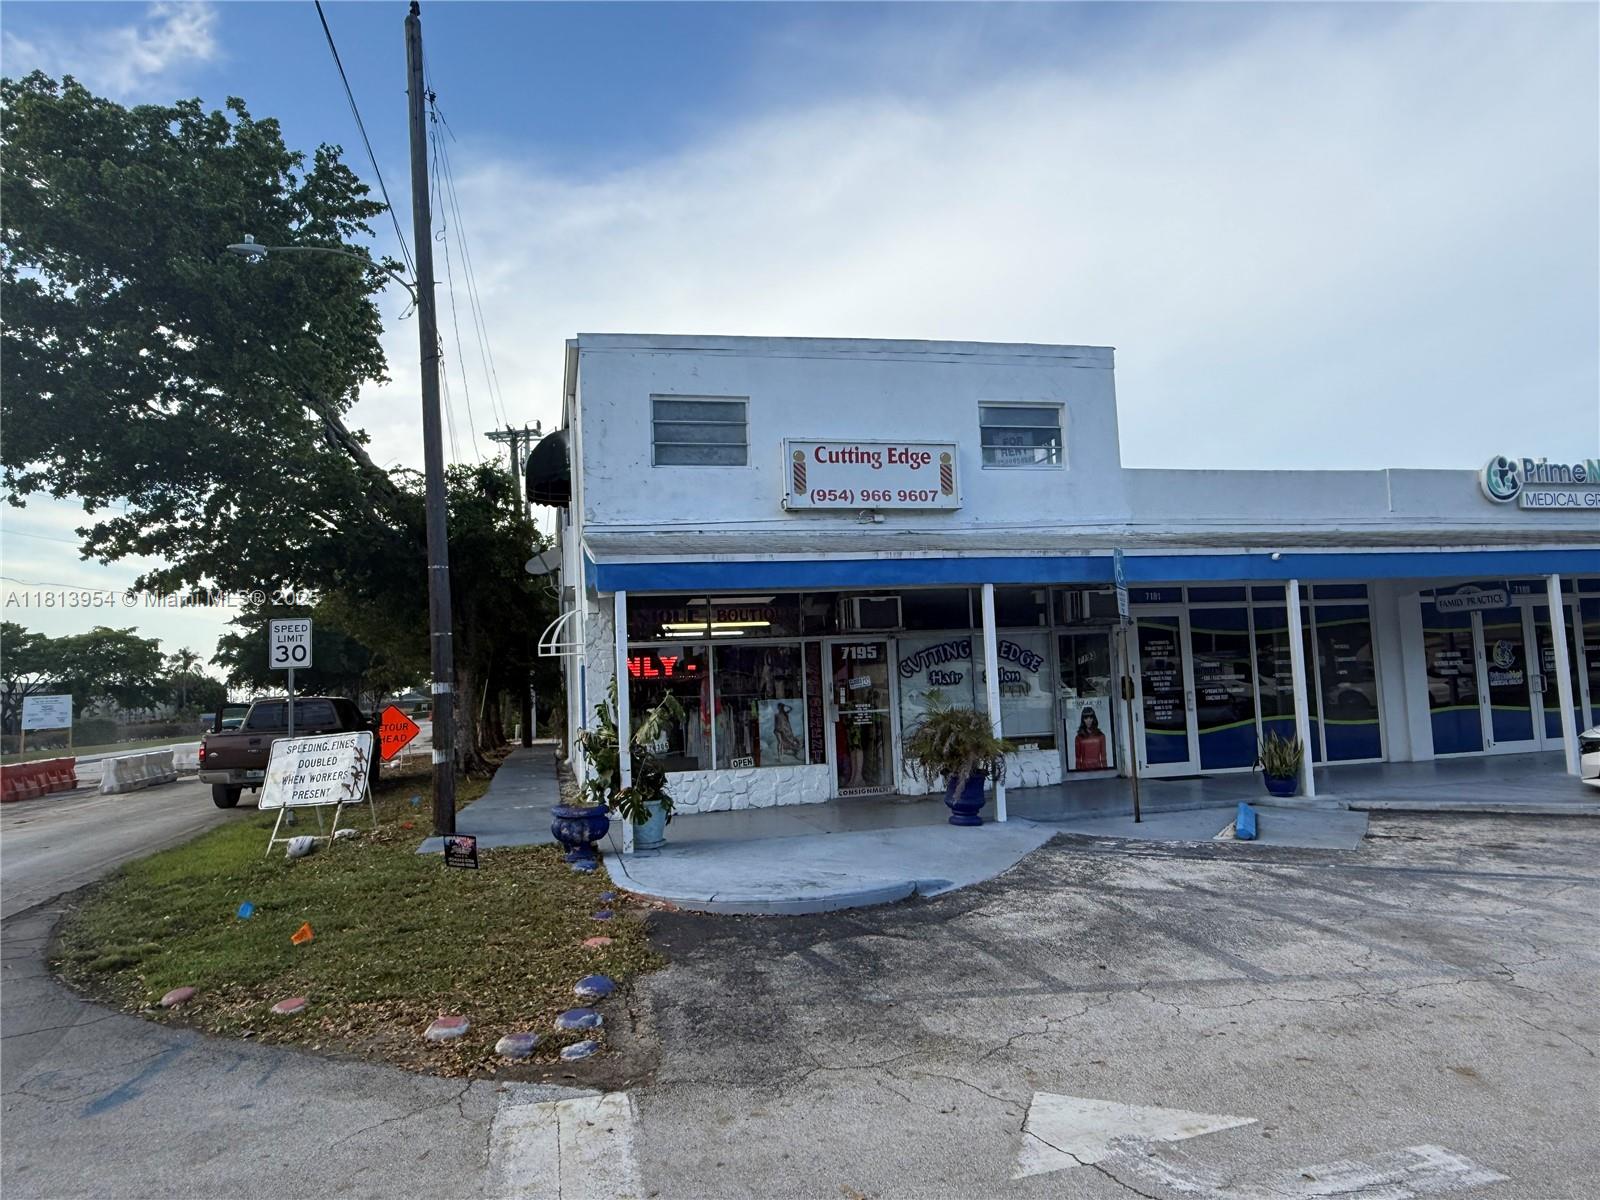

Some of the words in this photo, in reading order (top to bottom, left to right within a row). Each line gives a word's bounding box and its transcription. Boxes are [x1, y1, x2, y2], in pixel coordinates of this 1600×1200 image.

[814, 446, 882, 469] Cutting
[888, 447, 931, 470] Edge
[810, 489, 855, 504] (954)
[860, 489, 892, 503] 966
[897, 490, 938, 503] 9607
[1525, 492, 1581, 506] MEDICAL
[1466, 593, 1504, 607] PRACTICE
[274, 624, 308, 633] SPEED
[277, 634, 304, 644] LIMIT
[275, 645, 307, 663] 30
[841, 646, 877, 660] 7195
[898, 639, 972, 678] CUTTING
[999, 640, 1044, 673] EDGE
[627, 656, 678, 676] NLY
[929, 670, 963, 686] Hair
[983, 667, 1020, 684] lon
[331, 738, 356, 751] FINES
[298, 756, 338, 769] DOUBLED
[732, 757, 753, 768] OPEN
[282, 774, 306, 785] WHEN
[309, 770, 348, 783] WORKERS
[291, 787, 331, 800] PRESENT
